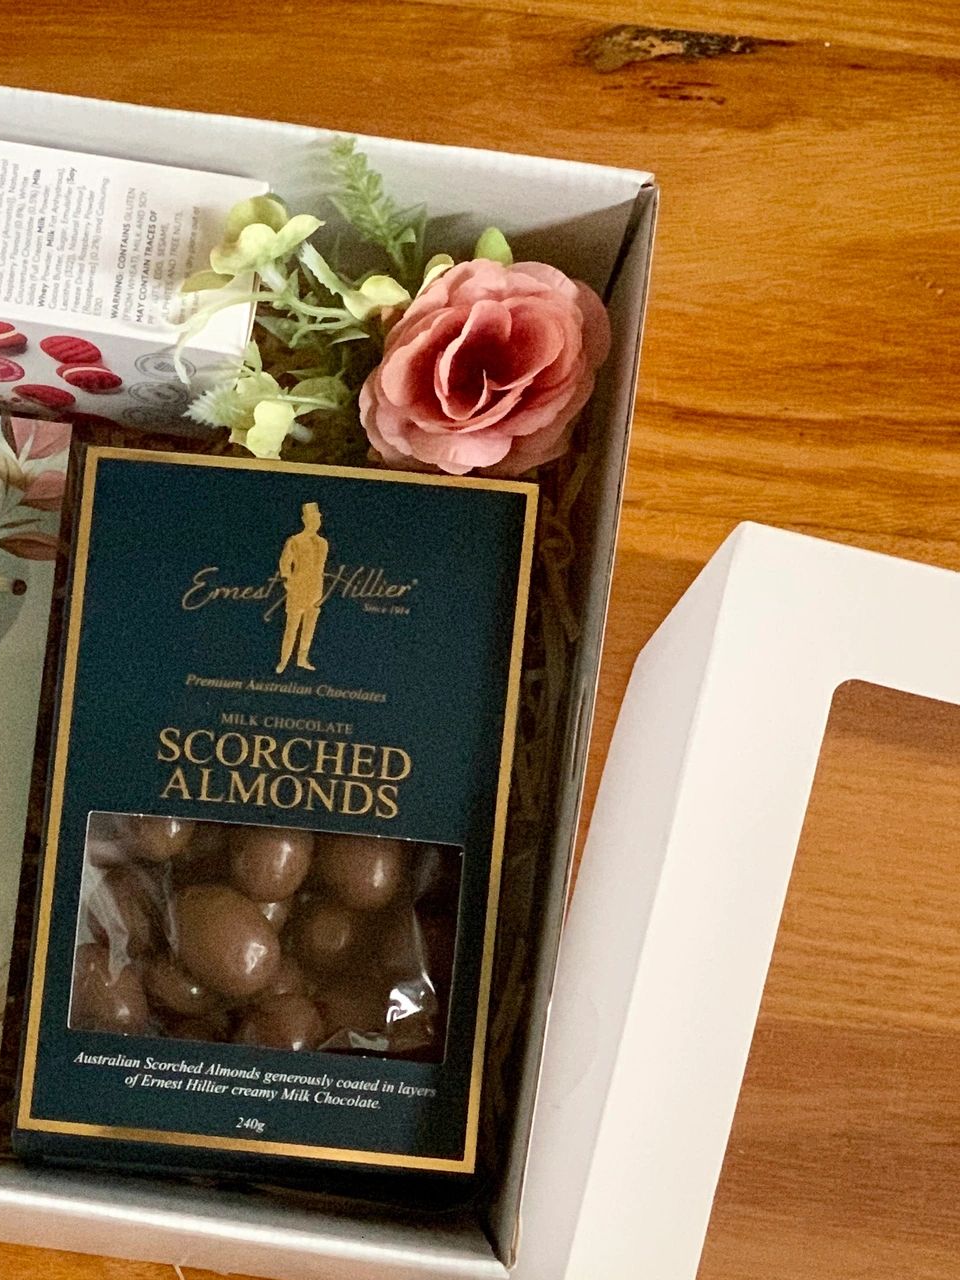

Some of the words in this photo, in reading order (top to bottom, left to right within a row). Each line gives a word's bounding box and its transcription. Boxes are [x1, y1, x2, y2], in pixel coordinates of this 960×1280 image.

[135, 209, 145, 228] AND
[148, 209, 157, 222] OF
[46, 229, 55, 246] Milk
[117, 222, 131, 269] CONTAINS
[144, 223, 155, 256] TRACES
[169, 235, 179, 257] TREE
[138, 258, 151, 300] CONTAIN
[38, 282, 49, 307] Whey
[135, 302, 145, 322] MAY
[181, 566, 289, 622] Ernest
[186, 673, 243, 689] Premium
[246, 679, 312, 695] Australian
[315, 684, 387, 703] Chocolates
[221, 712, 257, 727] MILK
[263, 716, 354, 735] CHOCOLATE
[157, 727, 413, 781] SCORCHED
[159, 766, 399, 819] ALMONDS
[74, 1052, 140, 1068] Australian
[144, 1057, 204, 1074] Scorched
[204, 1063, 260, 1080] Almonds
[263, 1071, 334, 1089] generously
[336, 1078, 380, 1093] coated
[381, 1080, 394, 1093] in
[397, 1082, 436, 1098] layers
[124, 1074, 142, 1088] of
[141, 1074, 183, 1090] Ernest
[185, 1078, 229, 1093] Hillier
[231, 1085, 278, 1100] creamy
[280, 1088, 310, 1102] Milk
[313, 1091, 381, 1110] Chocolate.
[235, 1117, 266, 1133] 240g
